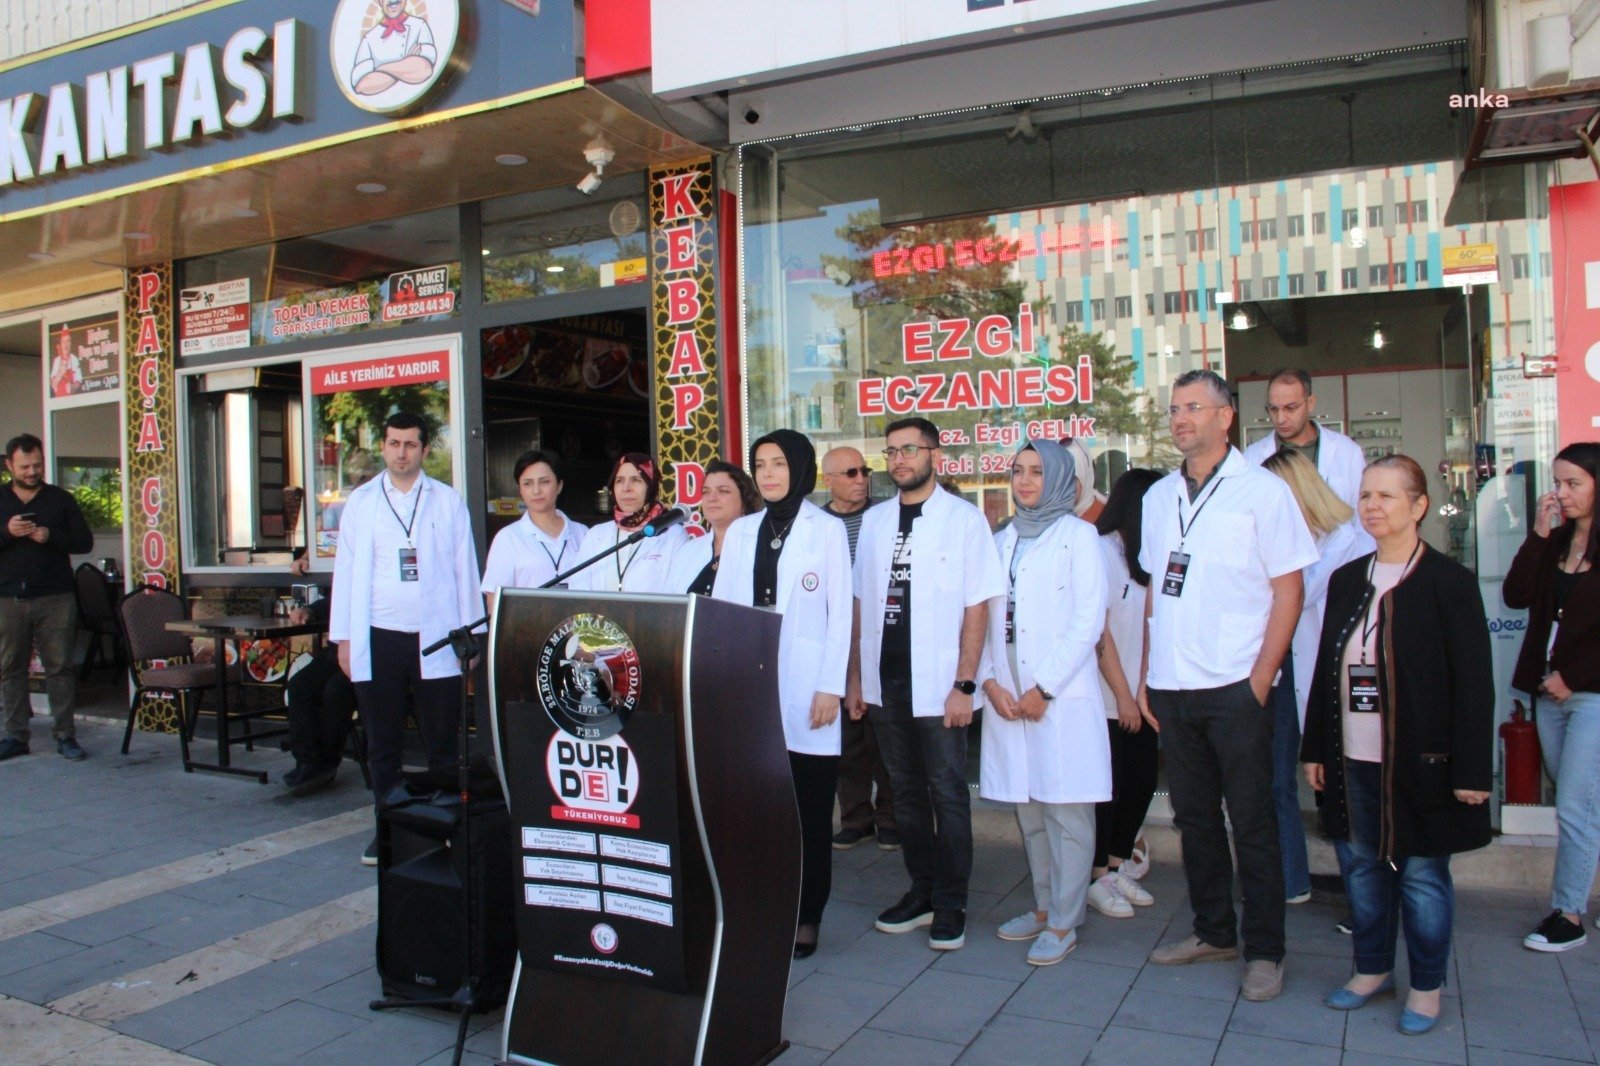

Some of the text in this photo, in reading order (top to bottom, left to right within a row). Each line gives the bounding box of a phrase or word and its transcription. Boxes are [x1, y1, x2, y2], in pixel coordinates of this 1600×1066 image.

[415, 269, 446, 287] PAKET
[273, 293, 370, 323] TOPLU YEMEK
[386, 297, 450, 319] 0422 324 44 34
[660, 171, 708, 430] KEBAP
[902, 302, 1035, 365] EZGİ
[323, 359, 440, 387] AİLE YERİMİZ VARDIR
[857, 354, 1093, 417] ECZANESİ
[974, 423, 1021, 446] Ezgi
[623, 666, 639, 710] ODASI
[578, 704, 598, 714] 1974
[563, 809, 627, 825] TÜKENİYORUZ
